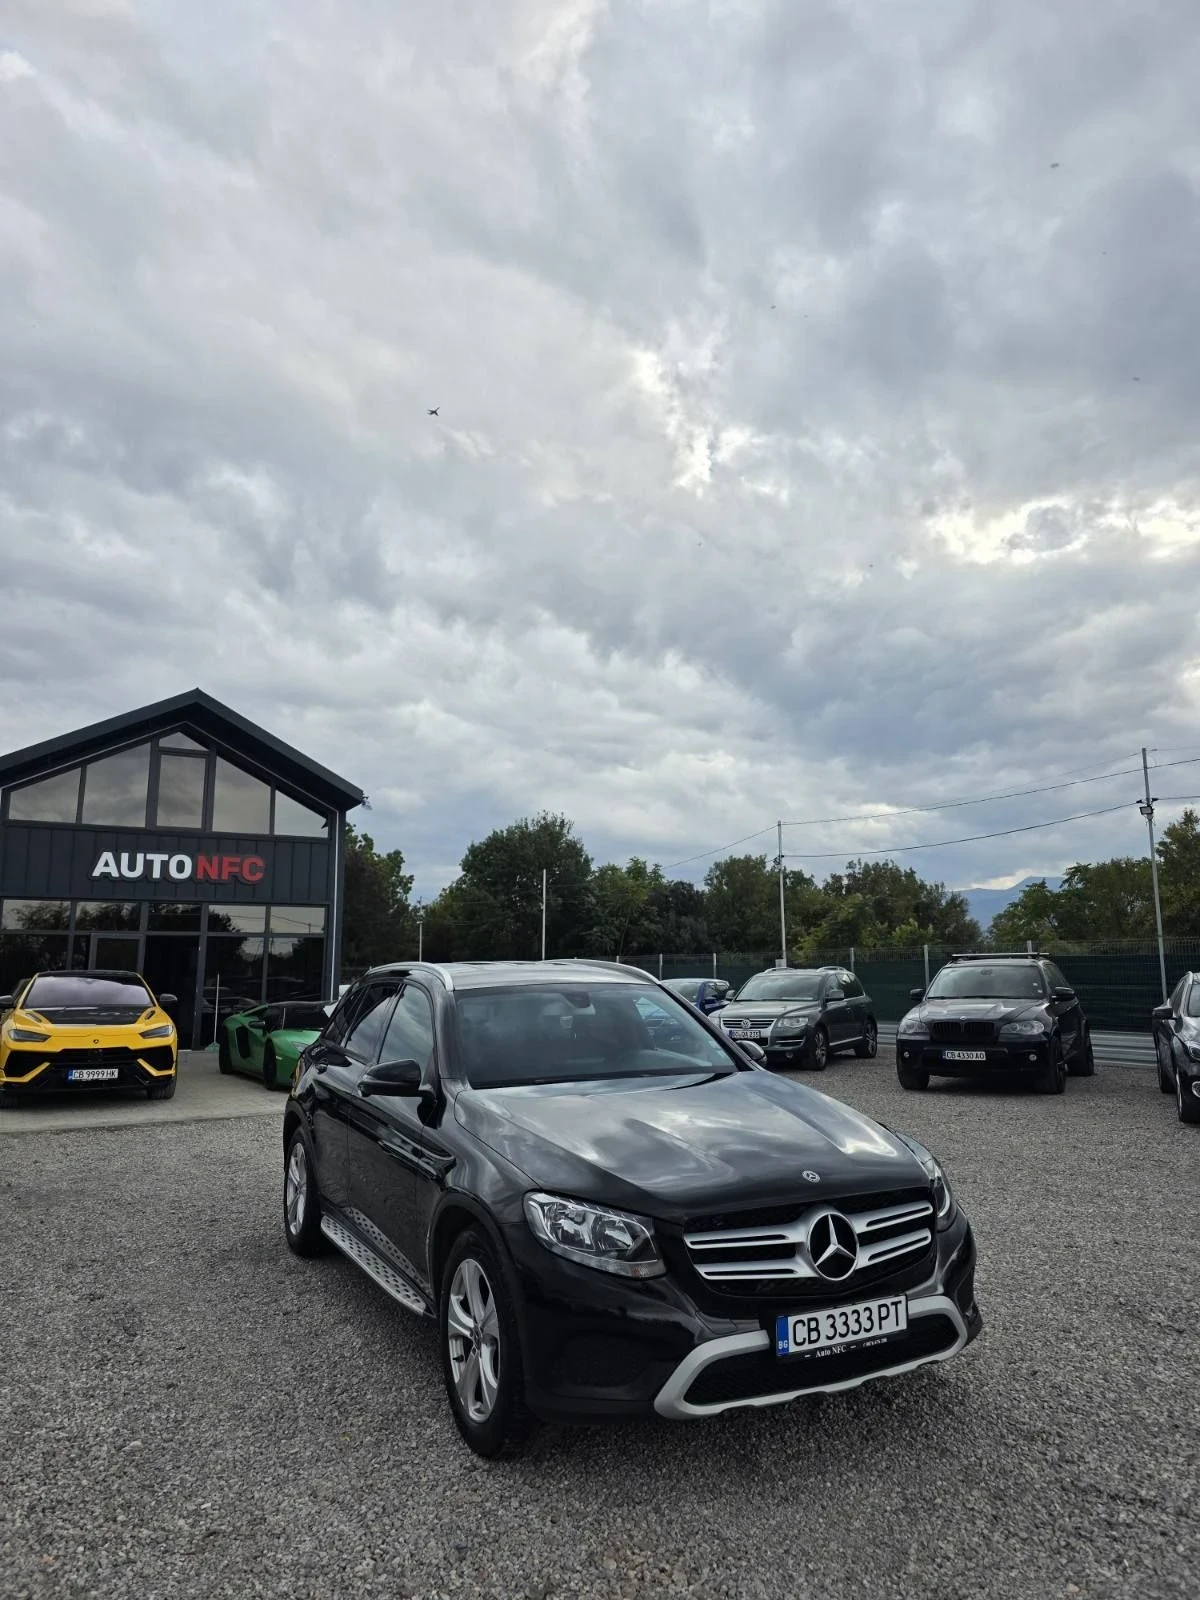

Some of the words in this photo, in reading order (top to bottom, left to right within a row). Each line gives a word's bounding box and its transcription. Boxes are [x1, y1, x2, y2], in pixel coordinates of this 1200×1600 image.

[92, 852, 193, 880] AUTO
[196, 855, 265, 881] NFC
[86, 1070, 105, 1079] 9999
[793, 1317, 821, 1347] CB
[825, 1306, 875, 1341] 3333
[878, 1300, 902, 1331] PT
[778, 1340, 788, 1349] BG
[816, 1349, 831, 1358] Auto
[832, 1345, 847, 1355] NFC
